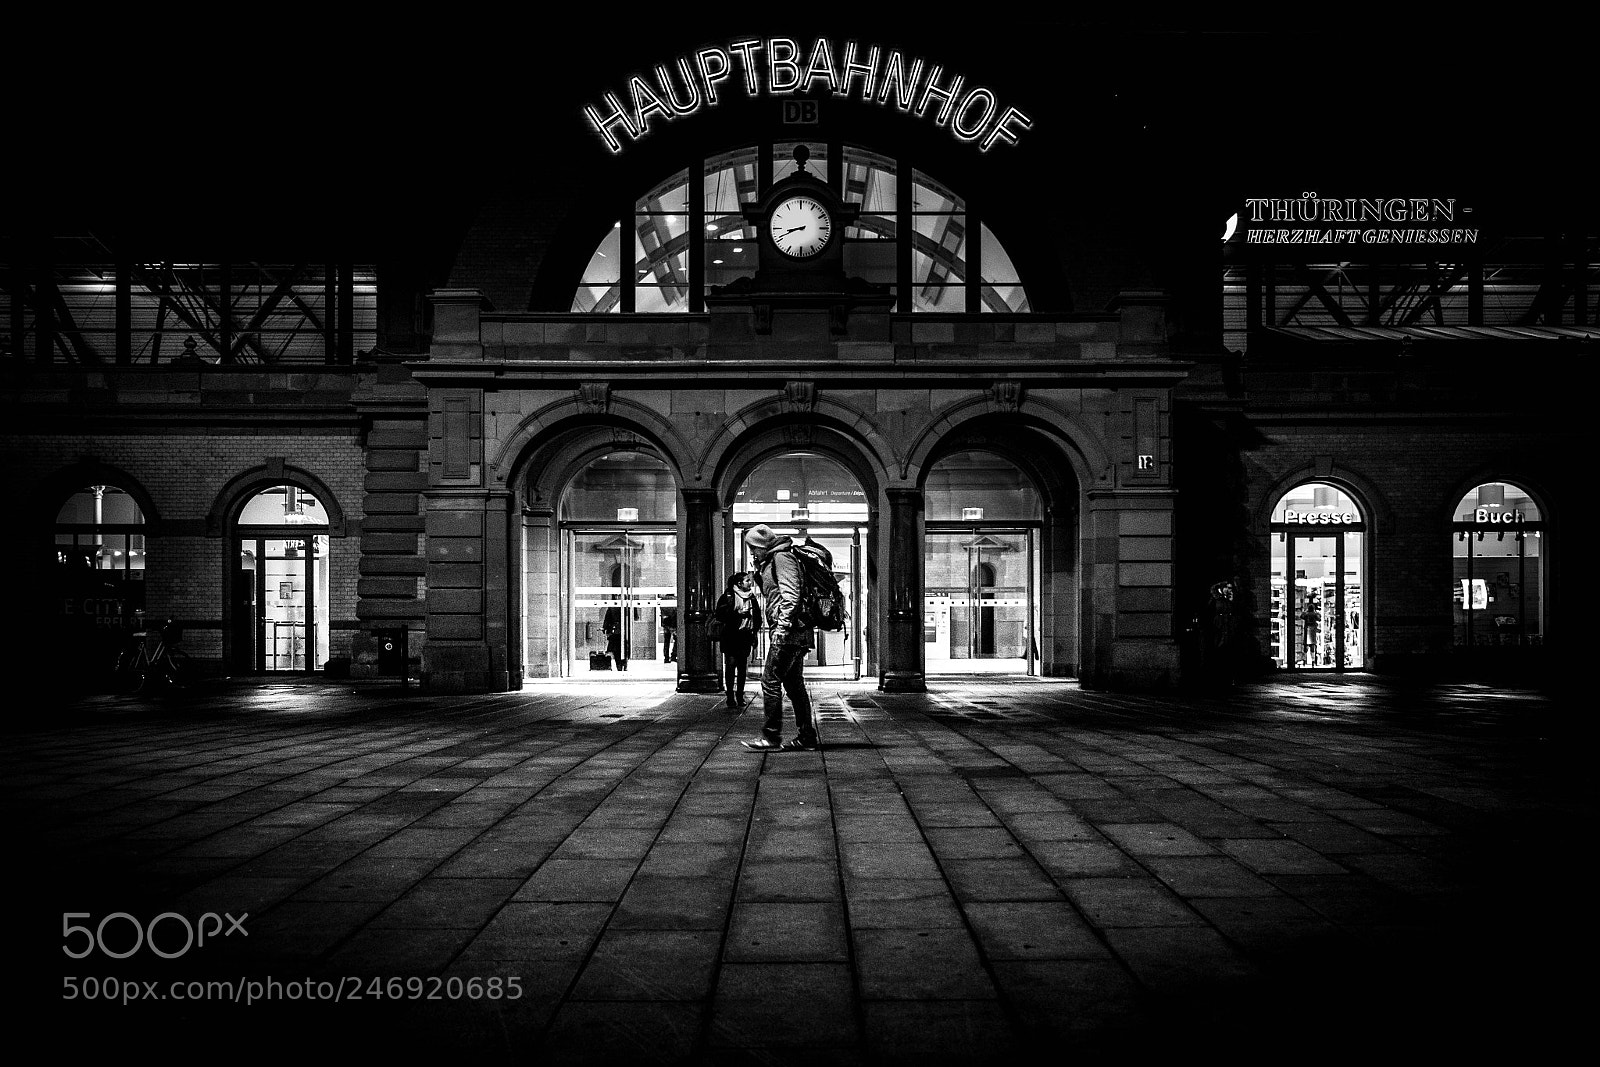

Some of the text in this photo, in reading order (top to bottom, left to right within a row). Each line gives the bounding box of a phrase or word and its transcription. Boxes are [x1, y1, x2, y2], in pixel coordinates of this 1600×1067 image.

[584, 37, 1033, 152] HAUPTBAHNHOF
[784, 101, 818, 122] DB
[1245, 192, 1456, 221] THÜRINGEN
[1284, 509, 1353, 524] Presse
[1475, 509, 1525, 523] Buch
